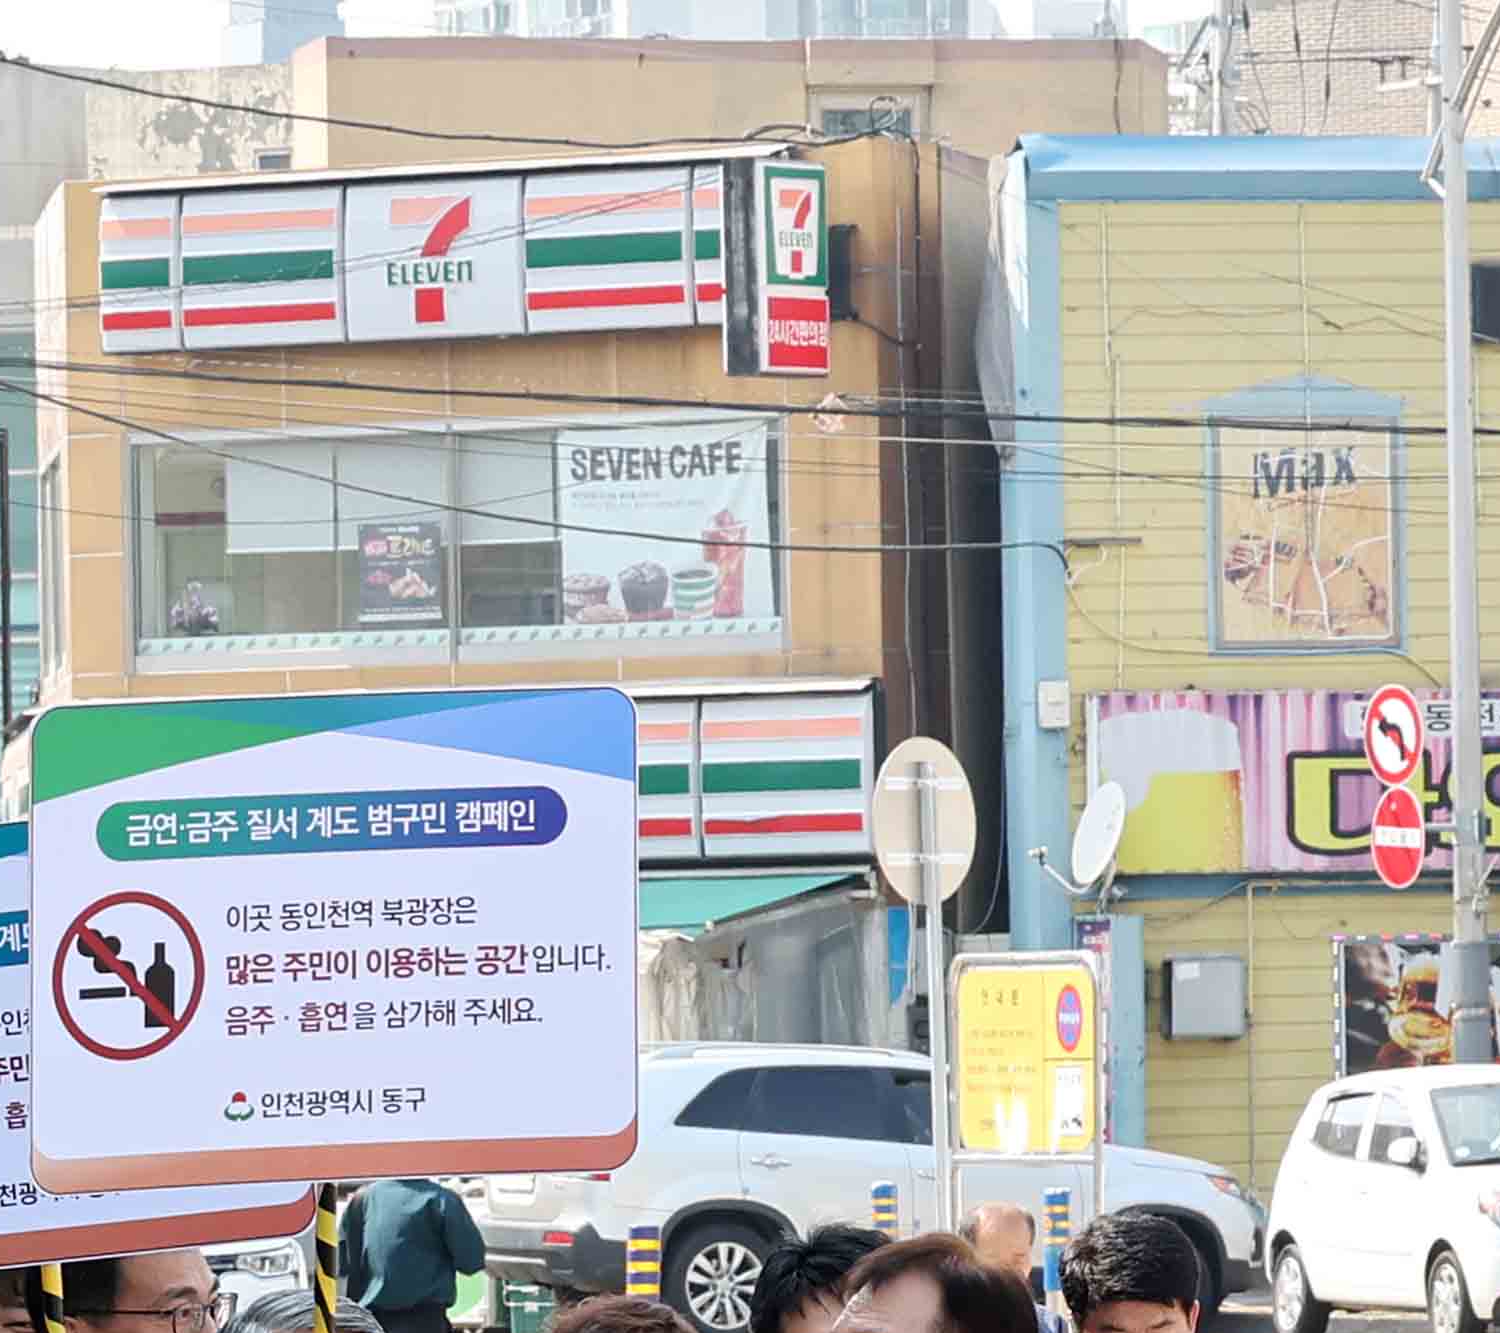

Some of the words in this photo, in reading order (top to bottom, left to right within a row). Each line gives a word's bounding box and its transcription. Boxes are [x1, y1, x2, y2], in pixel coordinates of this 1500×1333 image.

[569, 442, 664, 484] SEVEN
[667, 439, 743, 478] CAFE
[124, 810, 241, 849] 금연·금주
[245, 807, 299, 842] 질서
[305, 804, 361, 840] 계도
[366, 801, 447, 837] 범구민
[453, 798, 538, 834] 캠페인
[224, 903, 273, 934] 이곳
[278, 898, 374, 931] 동인천역
[379, 894, 479, 929] 북광장은
[224, 951, 275, 987] 많은
[281, 948, 359, 983] 주민이
[365, 944, 469, 980] 이용하는
[224, 1004, 276, 1038] 음주
[297, 1001, 375, 1036] 흡연을
[381, 997, 457, 1030] 삼가해
[462, 995, 546, 1027] 주세요.
[259, 1088, 374, 1121] 인천광역시
[380, 1085, 428, 1116] 동구
